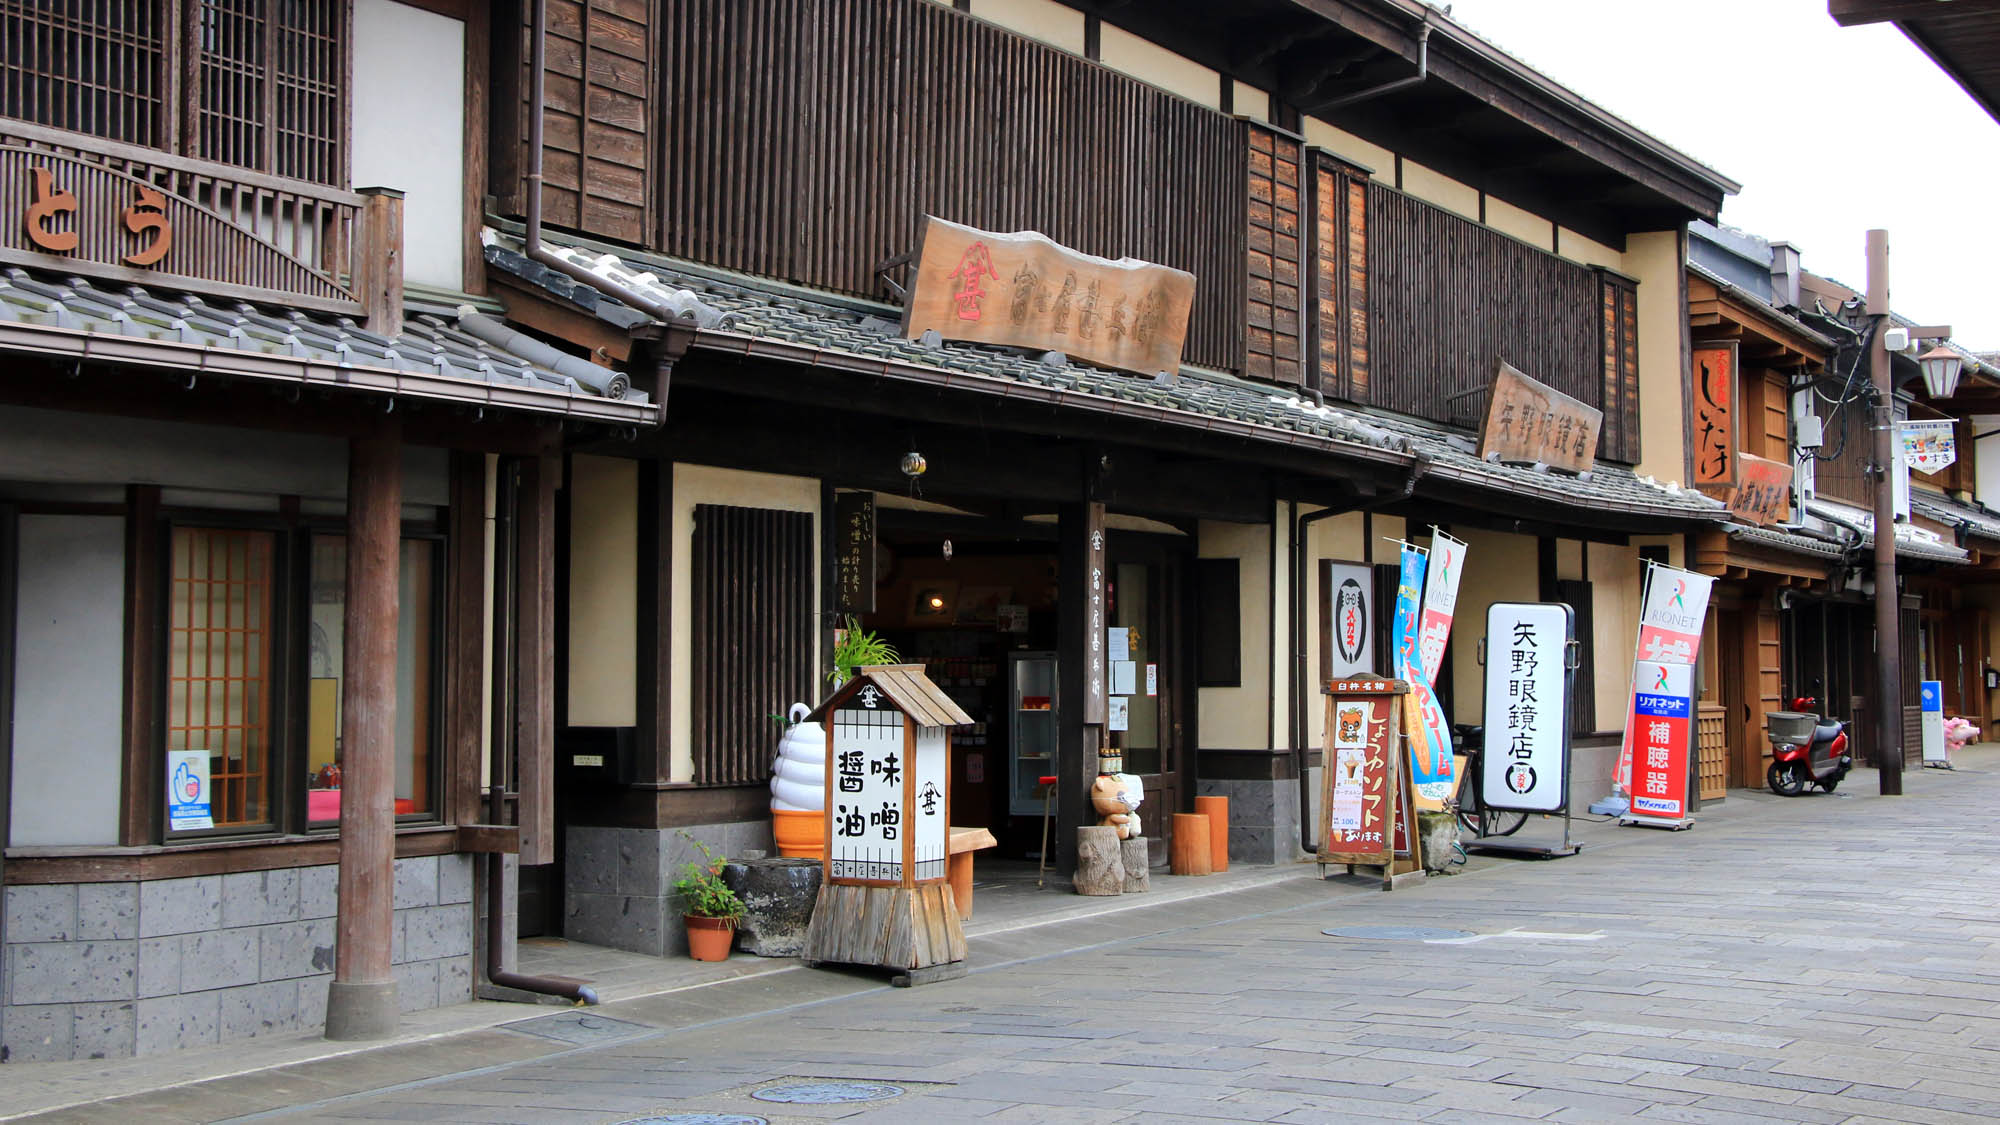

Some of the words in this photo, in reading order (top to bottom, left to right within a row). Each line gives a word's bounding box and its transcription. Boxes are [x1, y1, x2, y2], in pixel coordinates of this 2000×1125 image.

[1501, 400, 1589, 457] 矢野眼鏡店
[1700, 360, 1728, 480] しいたけ
[1346, 607, 1356, 649] メガネ
[1651, 608, 1697, 629] RIONET
[1338, 682, 1385, 691] 臼杵名物
[1404, 611, 1450, 777] ソフトクリーム
[1508, 620, 1538, 760] 矢野眼鏡店
[1639, 695, 1685, 709] リオネット
[836, 750, 866, 838] 醤油
[871, 752, 900, 840] 味噌
[1363, 701, 1387, 828] しょうゆソフト
[1645, 720, 1671, 795] 補聴器
